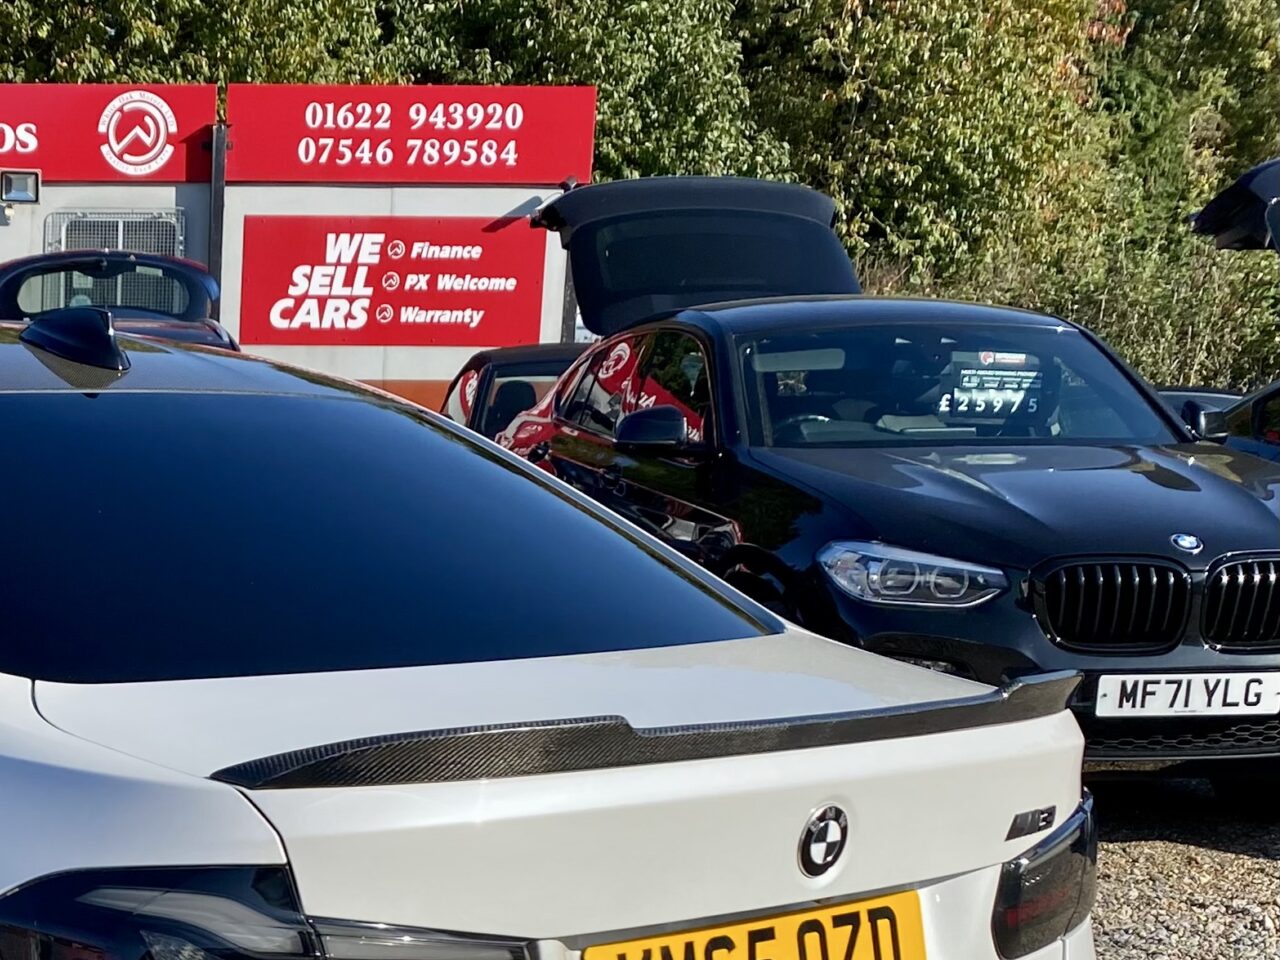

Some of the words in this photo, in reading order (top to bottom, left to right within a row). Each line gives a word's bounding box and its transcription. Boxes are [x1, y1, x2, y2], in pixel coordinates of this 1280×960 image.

[305, 102, 392, 129] 01622
[408, 102, 524, 130] 943920
[297, 138, 394, 165] 07546
[406, 139, 518, 166] 789584
[325, 233, 385, 264] WE
[410, 242, 483, 261] Finance
[288, 265, 374, 297] SELL
[404, 274, 428, 290] PX
[437, 274, 517, 292] Welcome
[269, 298, 370, 330] CARS
[399, 306, 485, 331] Warranty
[1118, 679, 1192, 709] MF71
[1203, 678, 1263, 707] YLG
[1004, 805, 1057, 841] M3
